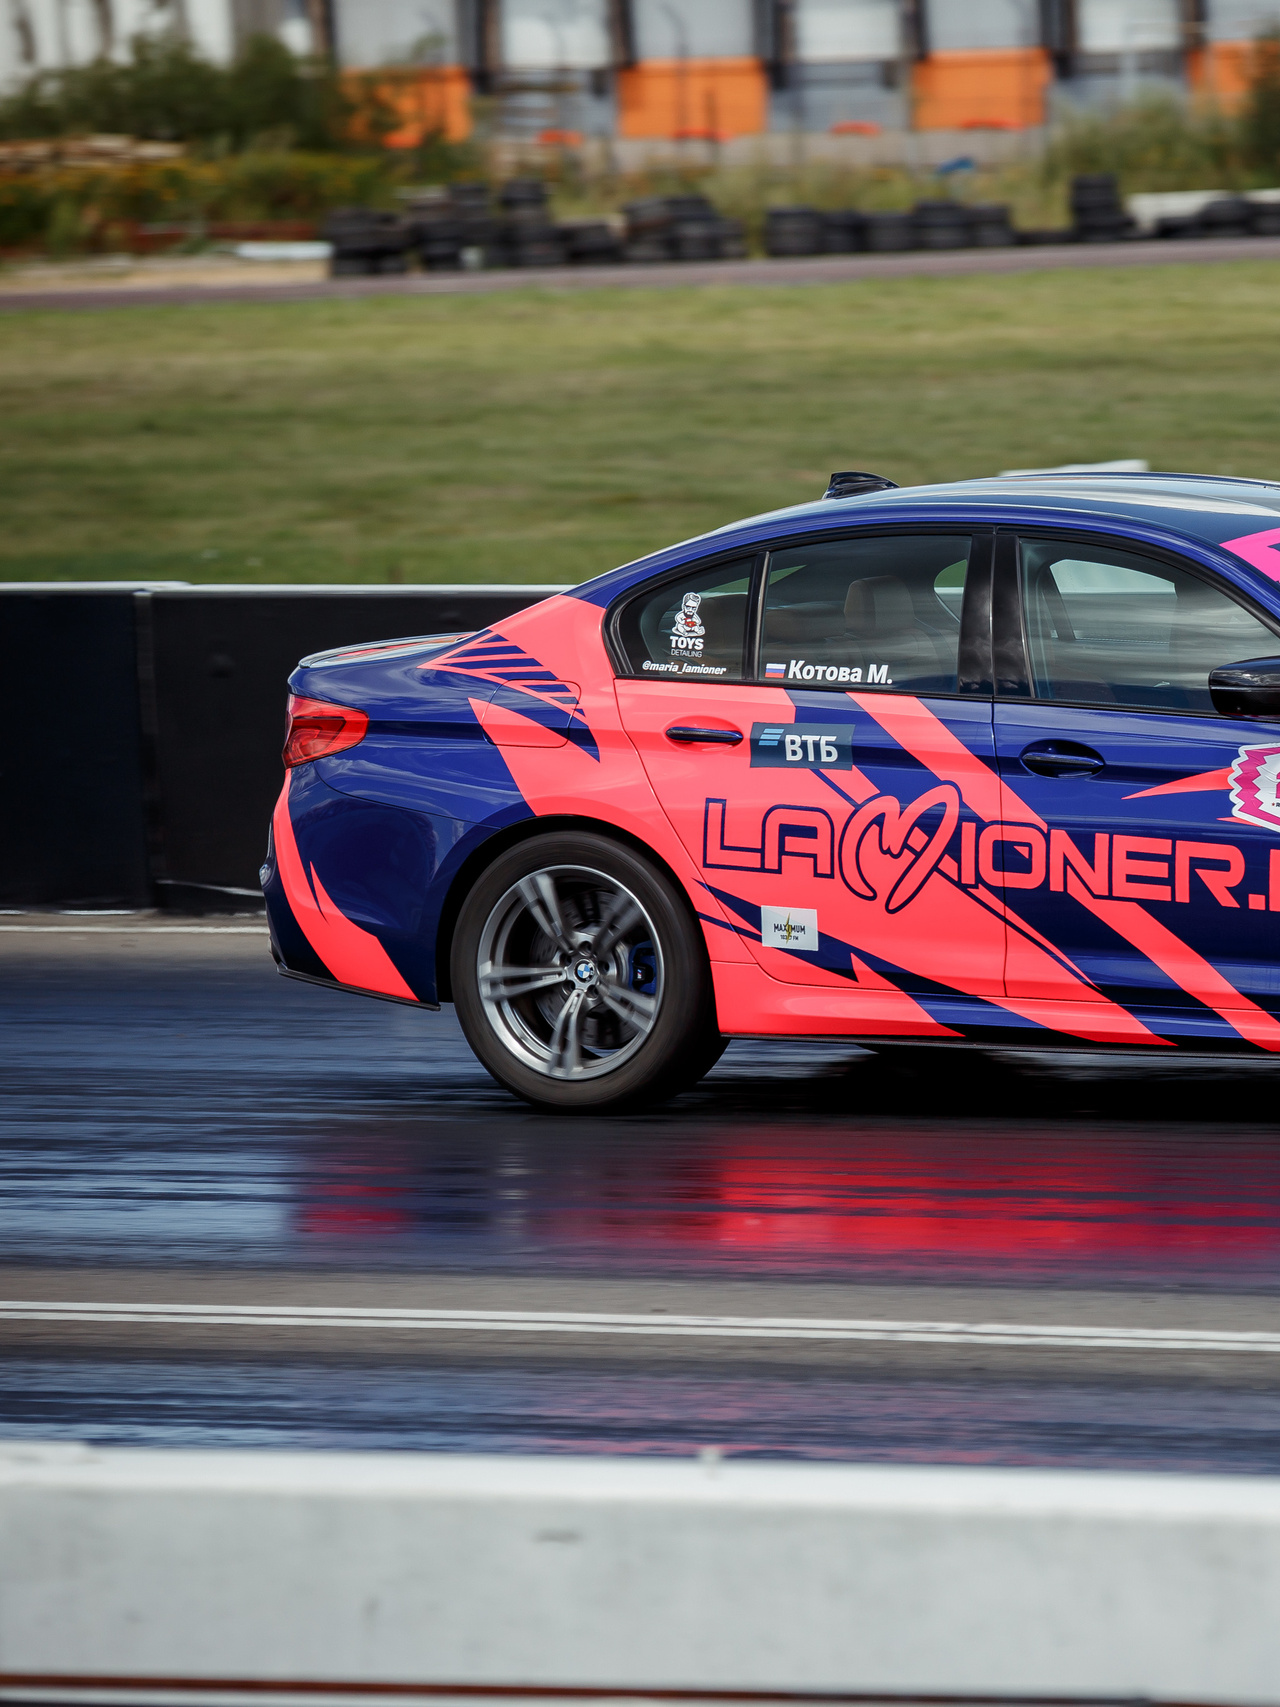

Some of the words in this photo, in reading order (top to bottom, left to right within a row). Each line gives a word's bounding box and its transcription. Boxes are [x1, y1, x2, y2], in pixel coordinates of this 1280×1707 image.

[669, 635, 704, 651] TOYS
[670, 648, 703, 658] DETAILING
[641, 660, 727, 675] @maria_lamioner
[788, 660, 863, 682] Котова
[867, 663, 893, 685] М.
[784, 734, 839, 763] ВТБ
[773, 923, 806, 935] MAXIMUM
